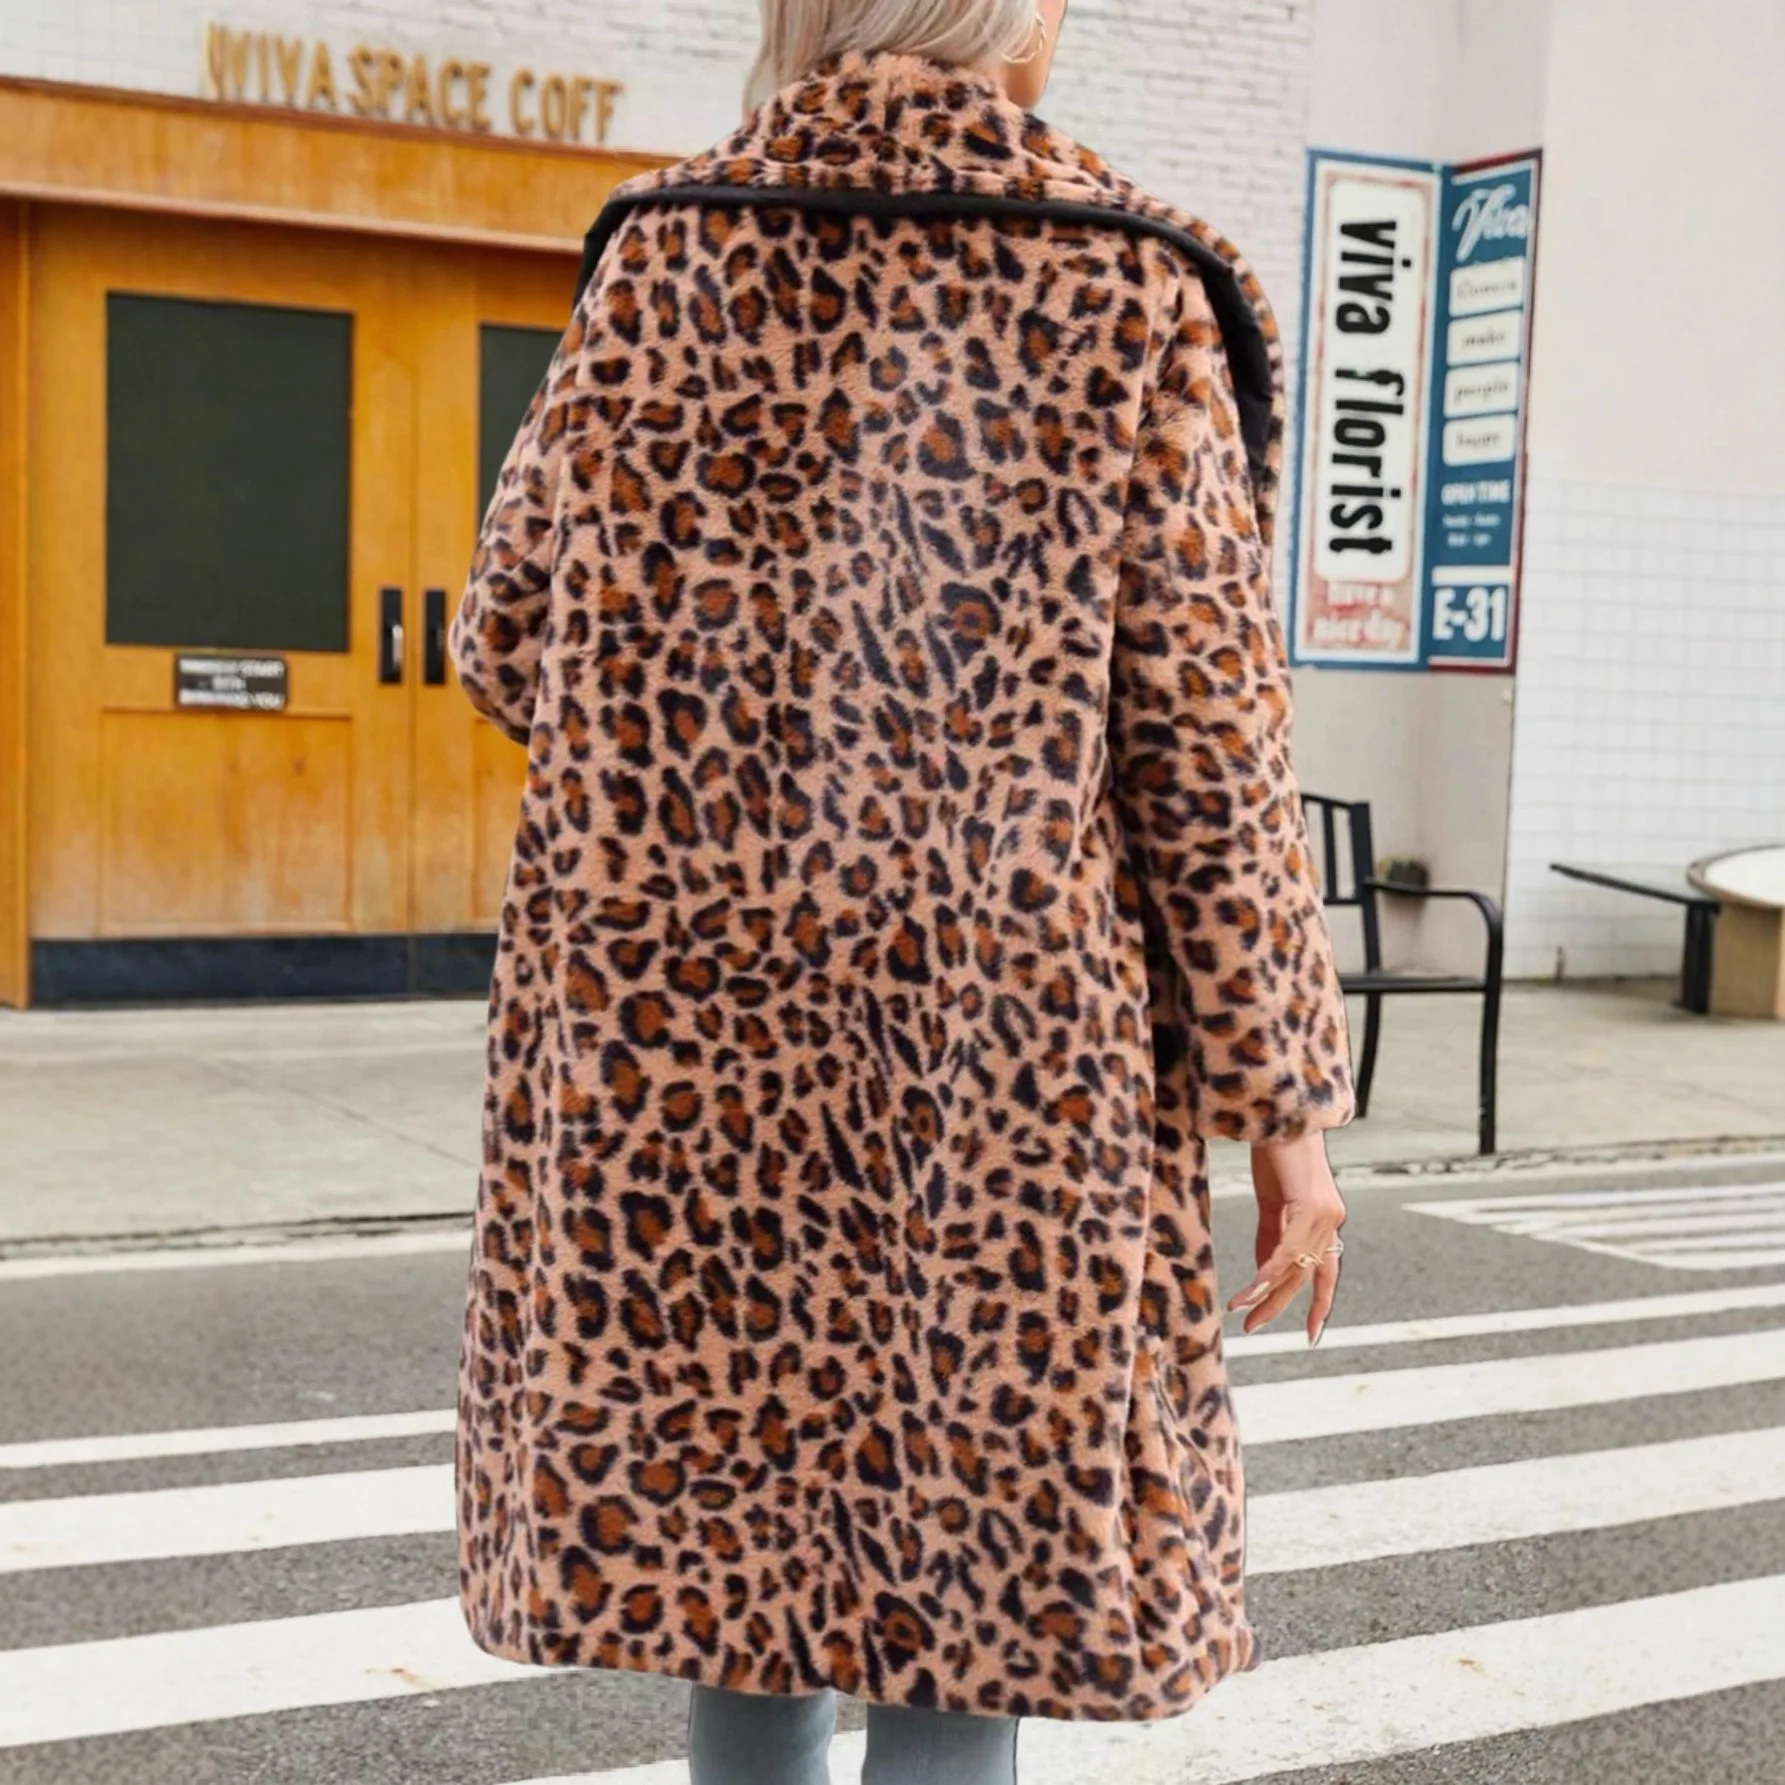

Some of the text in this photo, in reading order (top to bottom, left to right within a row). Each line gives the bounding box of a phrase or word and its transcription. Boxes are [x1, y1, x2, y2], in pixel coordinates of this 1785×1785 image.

[346, 44, 491, 132] SPACE
[508, 66, 624, 142] COFF
[1329, 220, 1412, 555] viva florist
[1432, 586, 1506, 641] E-31
